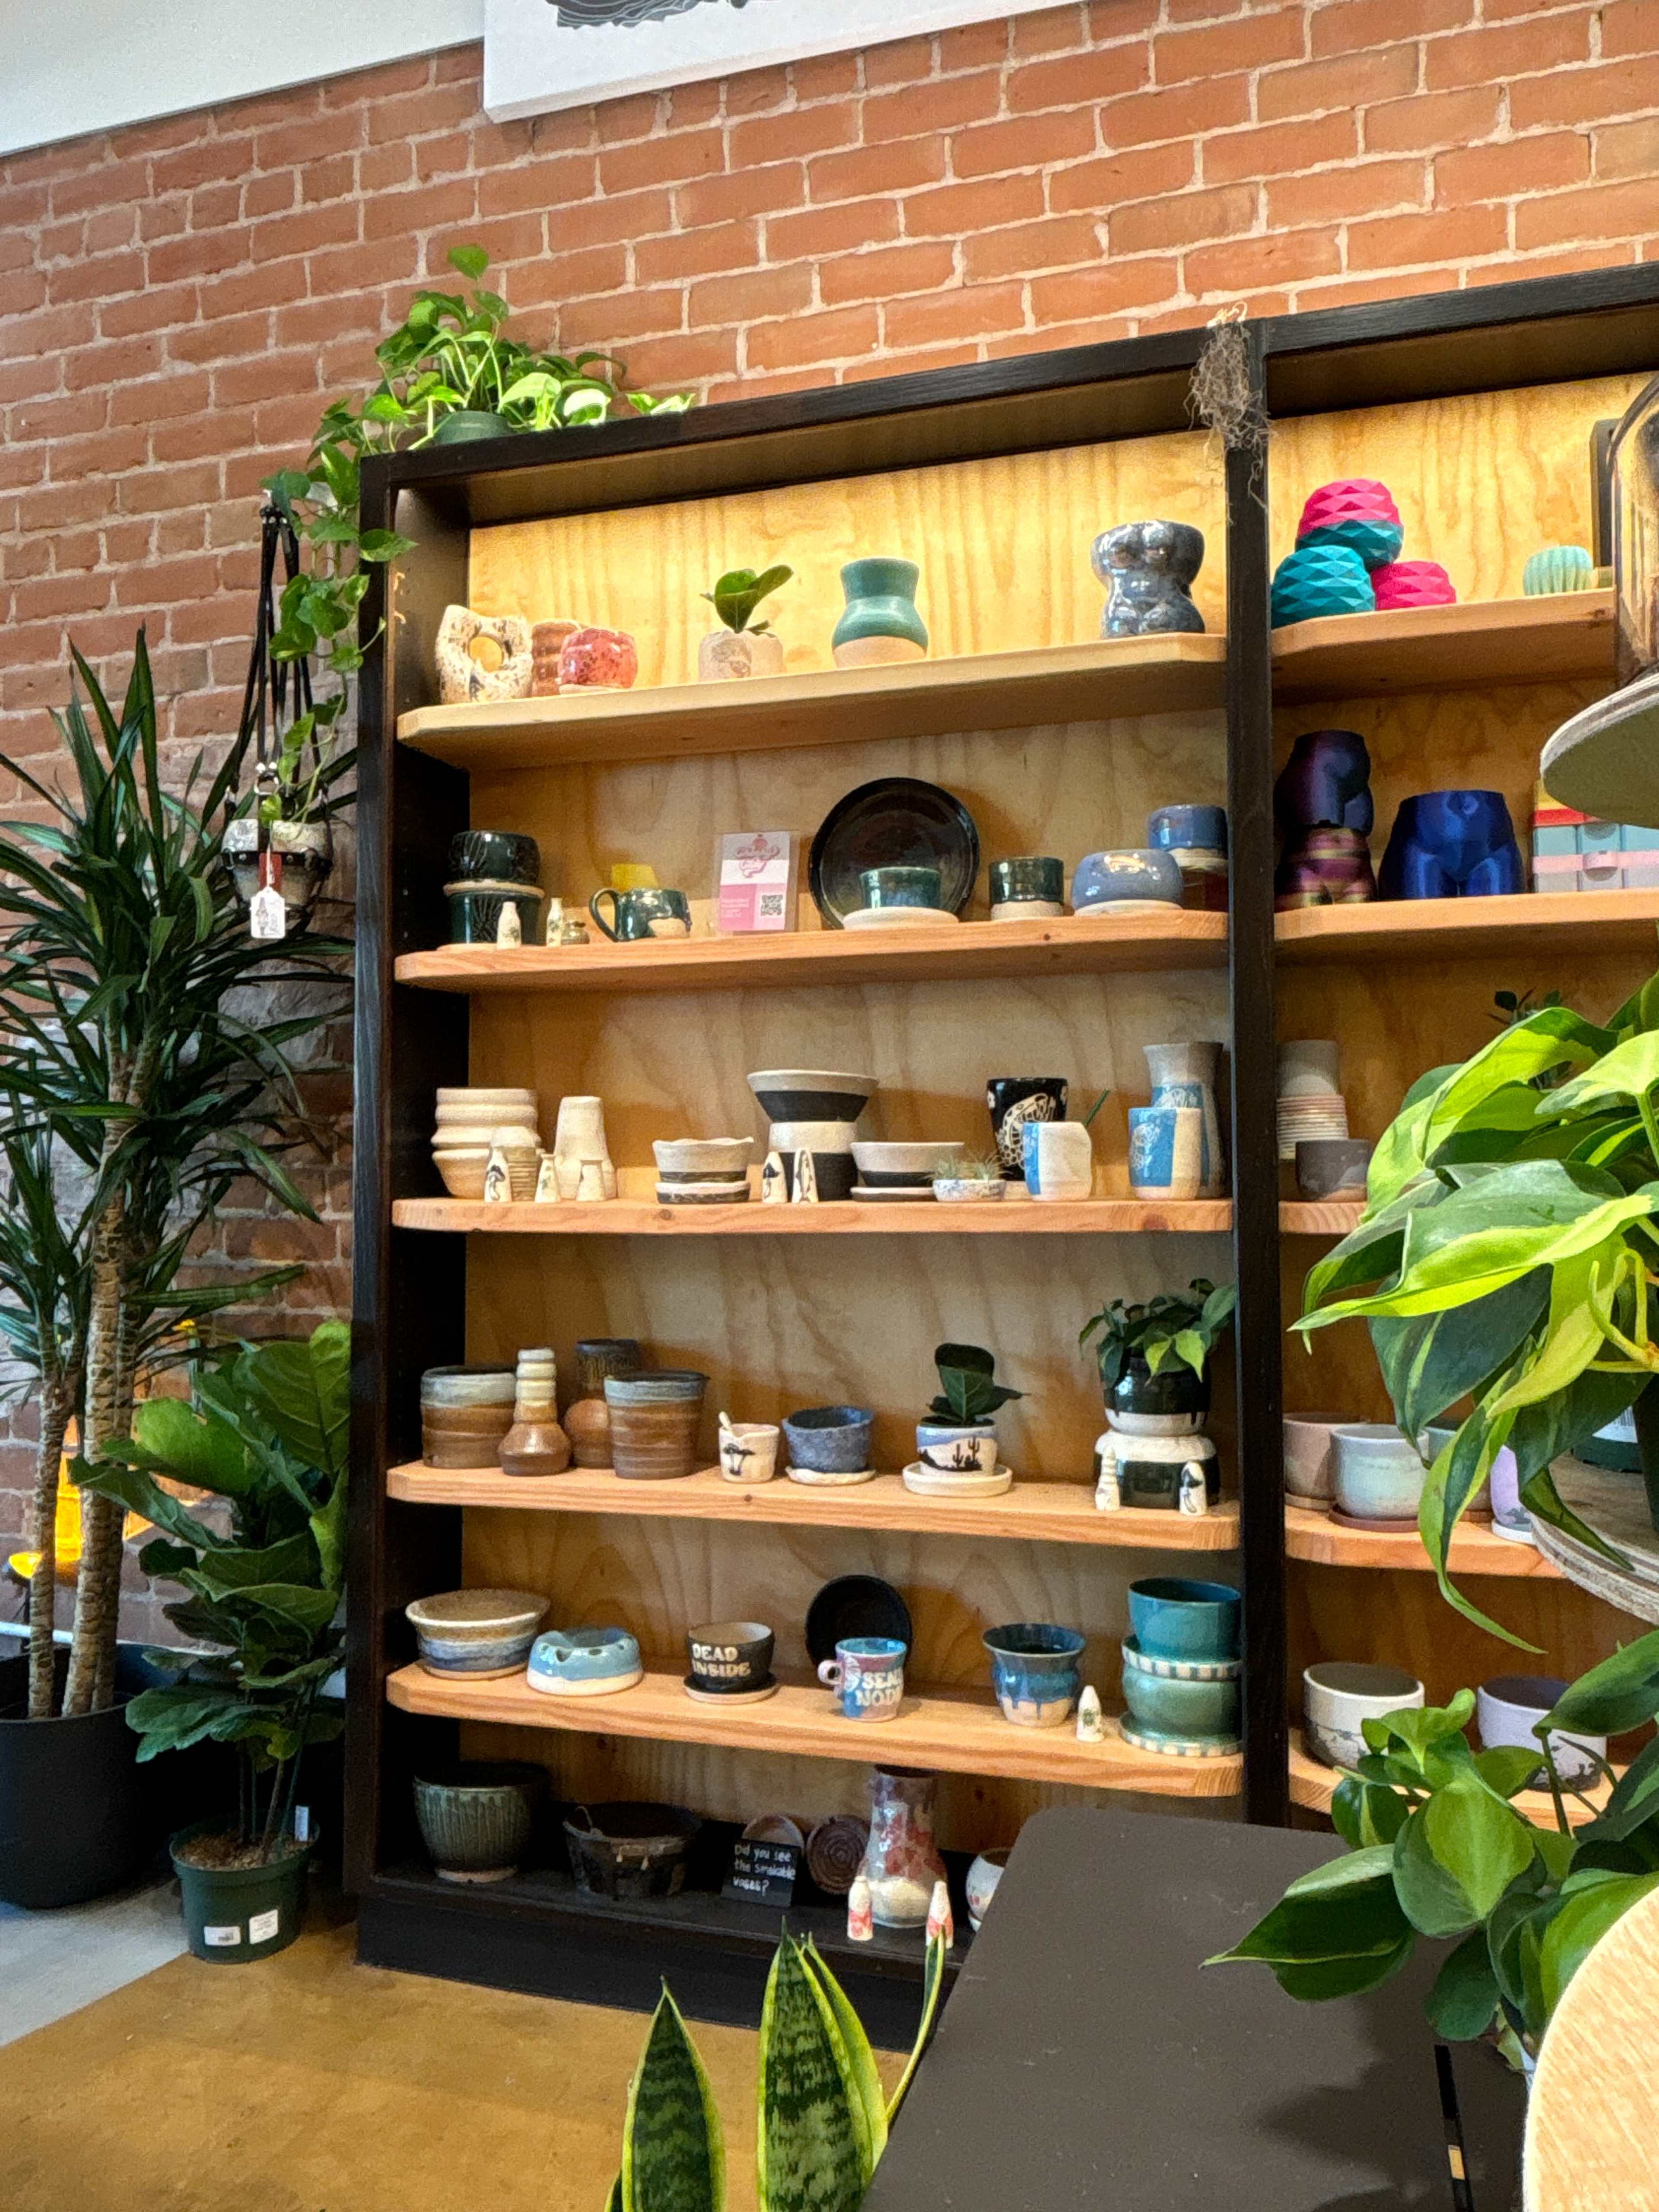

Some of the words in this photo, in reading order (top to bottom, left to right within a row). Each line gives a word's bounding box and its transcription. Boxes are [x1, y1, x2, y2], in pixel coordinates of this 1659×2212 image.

[692, 1643, 737, 1662] DEAD
[692, 1659, 751, 1677] INSIDE
[734, 1844, 750, 1856] Did
[753, 1848, 769, 1862] you
[774, 1851, 791, 1862] see
[734, 1858, 750, 1872] the
